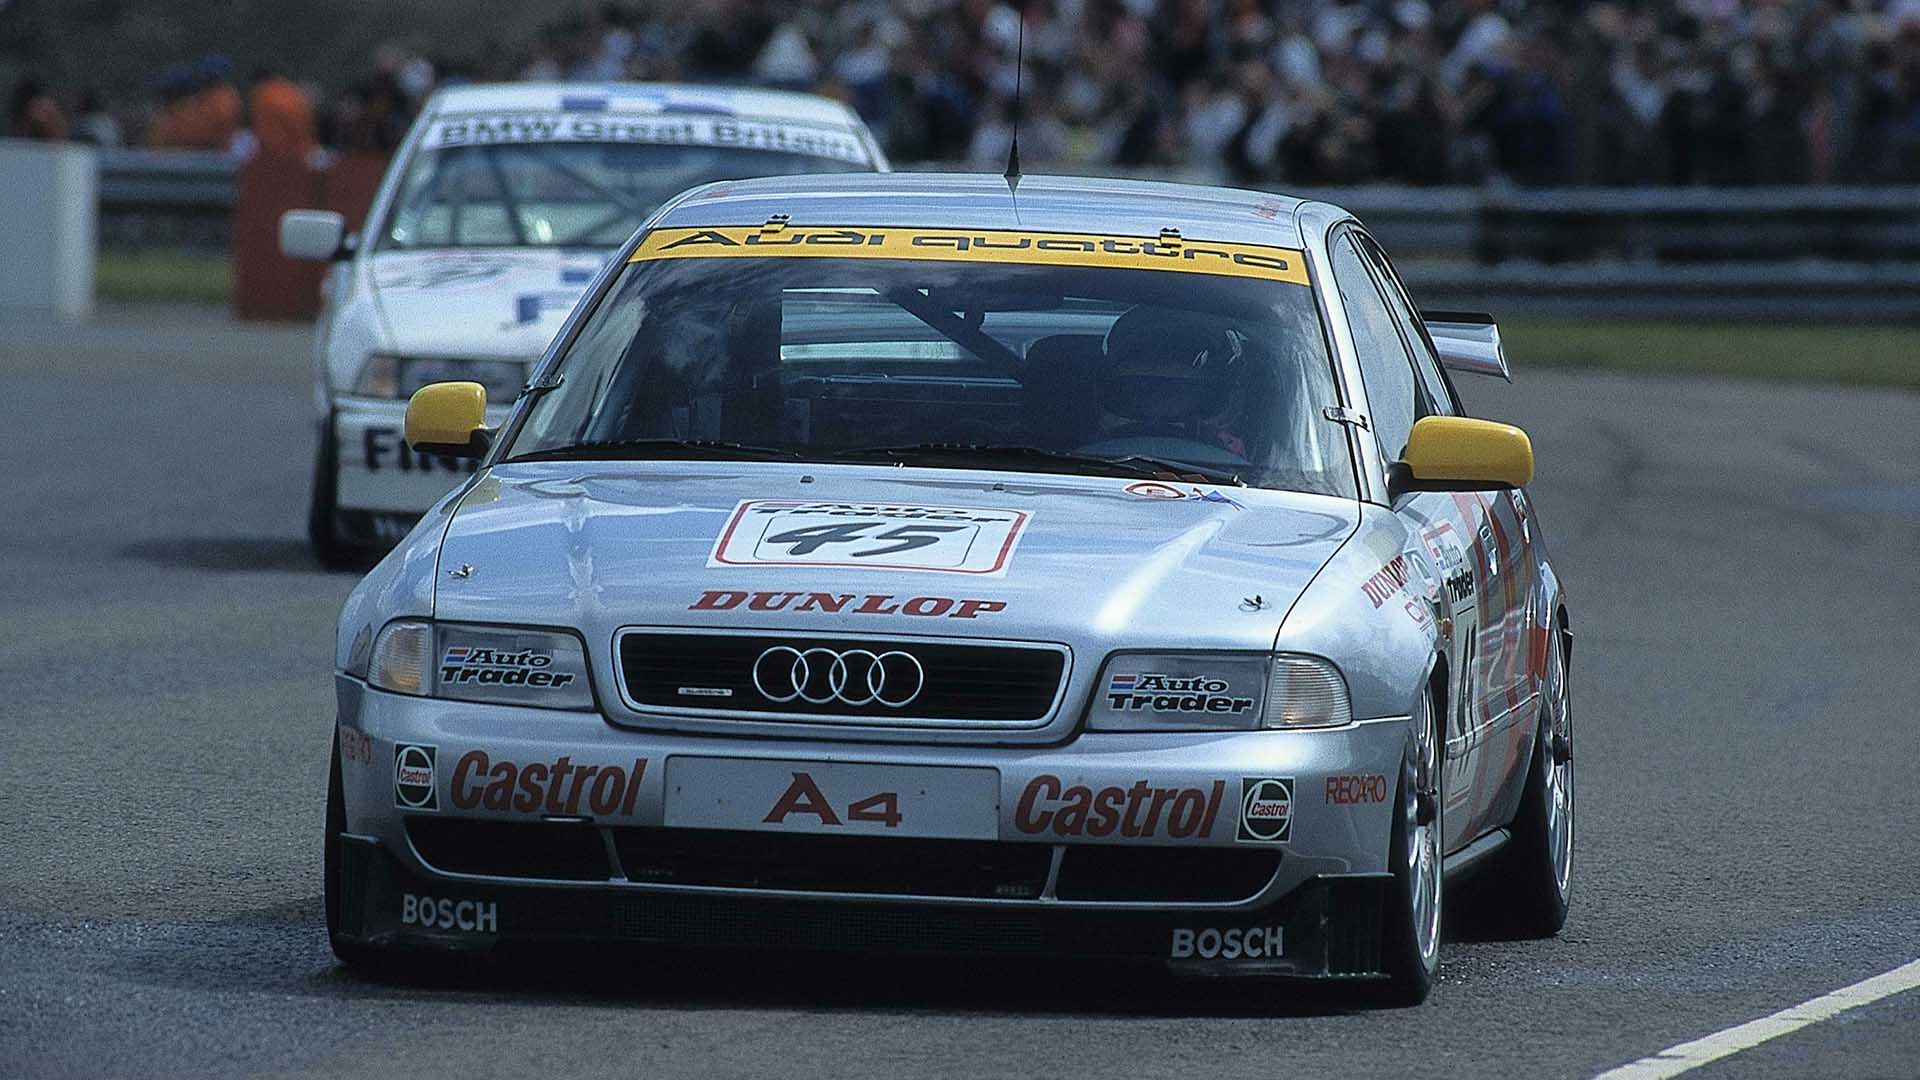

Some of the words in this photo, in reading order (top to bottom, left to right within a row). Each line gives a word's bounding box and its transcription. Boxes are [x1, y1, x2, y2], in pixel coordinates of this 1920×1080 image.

[440, 119, 560, 144] BMW
[572, 117, 692, 144] Great
[714, 120, 866, 159] Britain
[656, 230, 886, 250] Audi
[911, 235, 1289, 270] quattro
[751, 508, 1011, 522] Trader
[797, 503, 969, 515] Auto
[767, 523, 969, 557] 45
[689, 590, 1009, 619] DUNLOP
[466, 648, 551, 667] Auto
[441, 665, 575, 687] Trader
[1135, 674, 1228, 692] Auto
[1108, 693, 1252, 713] Trader
[400, 768, 432, 783] Castrol
[451, 749, 648, 816] Castrol
[1325, 774, 1386, 805] RECARO
[762, 772, 902, 828] A4
[1015, 774, 1226, 839] Castrol
[1251, 801, 1289, 817] Castrol
[402, 893, 497, 932] BOSCH
[1171, 926, 1284, 960] BOSCH
